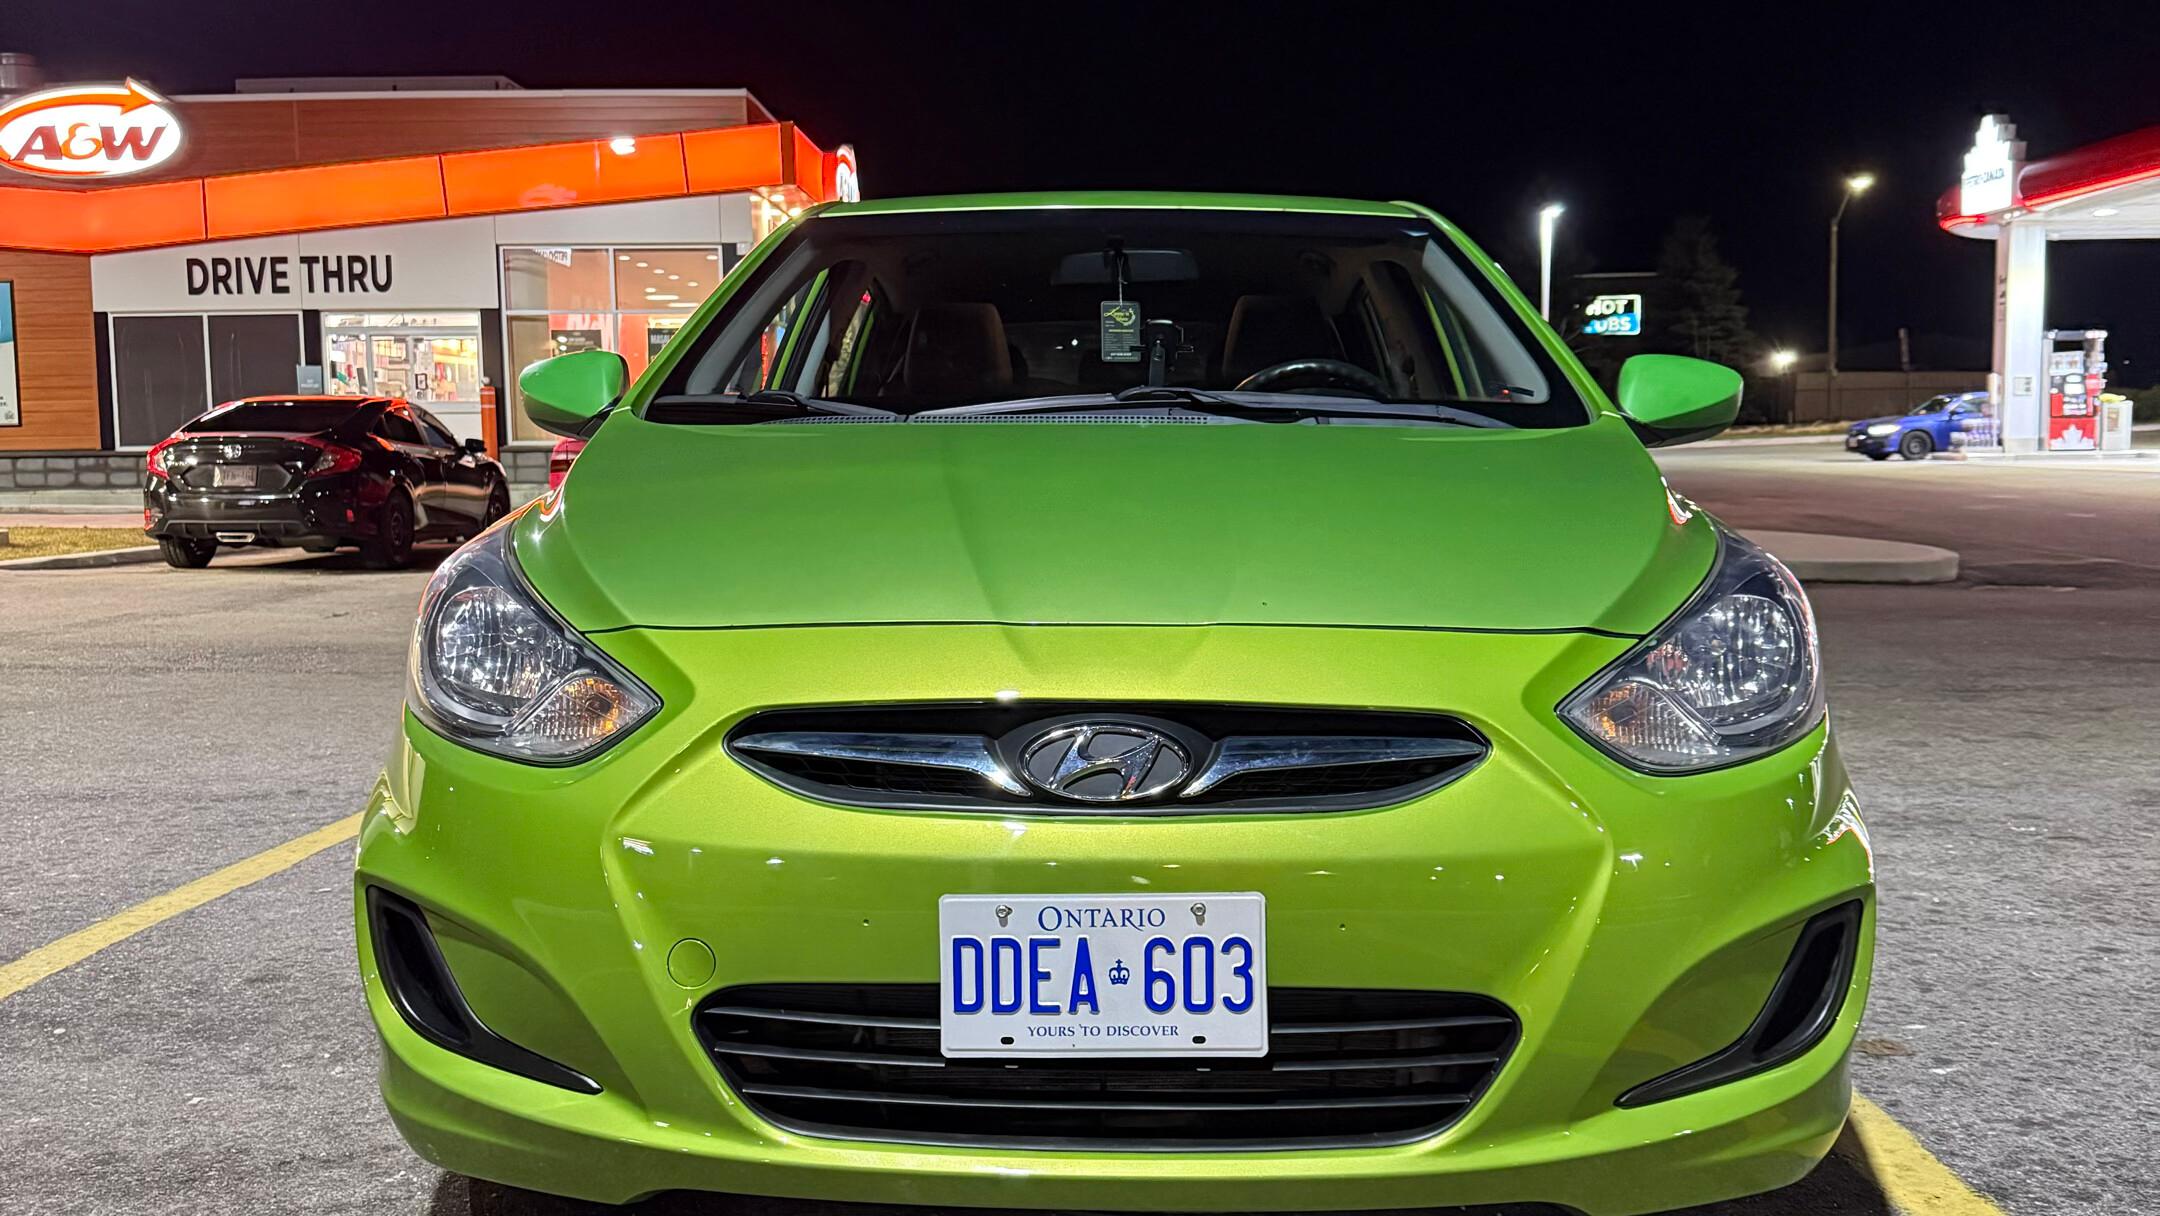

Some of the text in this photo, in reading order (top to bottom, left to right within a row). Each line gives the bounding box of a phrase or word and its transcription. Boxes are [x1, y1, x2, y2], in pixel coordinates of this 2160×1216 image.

[8, 123, 168, 160] A&W
[186, 255, 392, 295] DRIVE THRU
[1585, 316, 1631, 332] UBS
[952, 936, 1254, 1014] DDEA 603
[1027, 1024, 1179, 1037] YOURS TO DISCOVER
